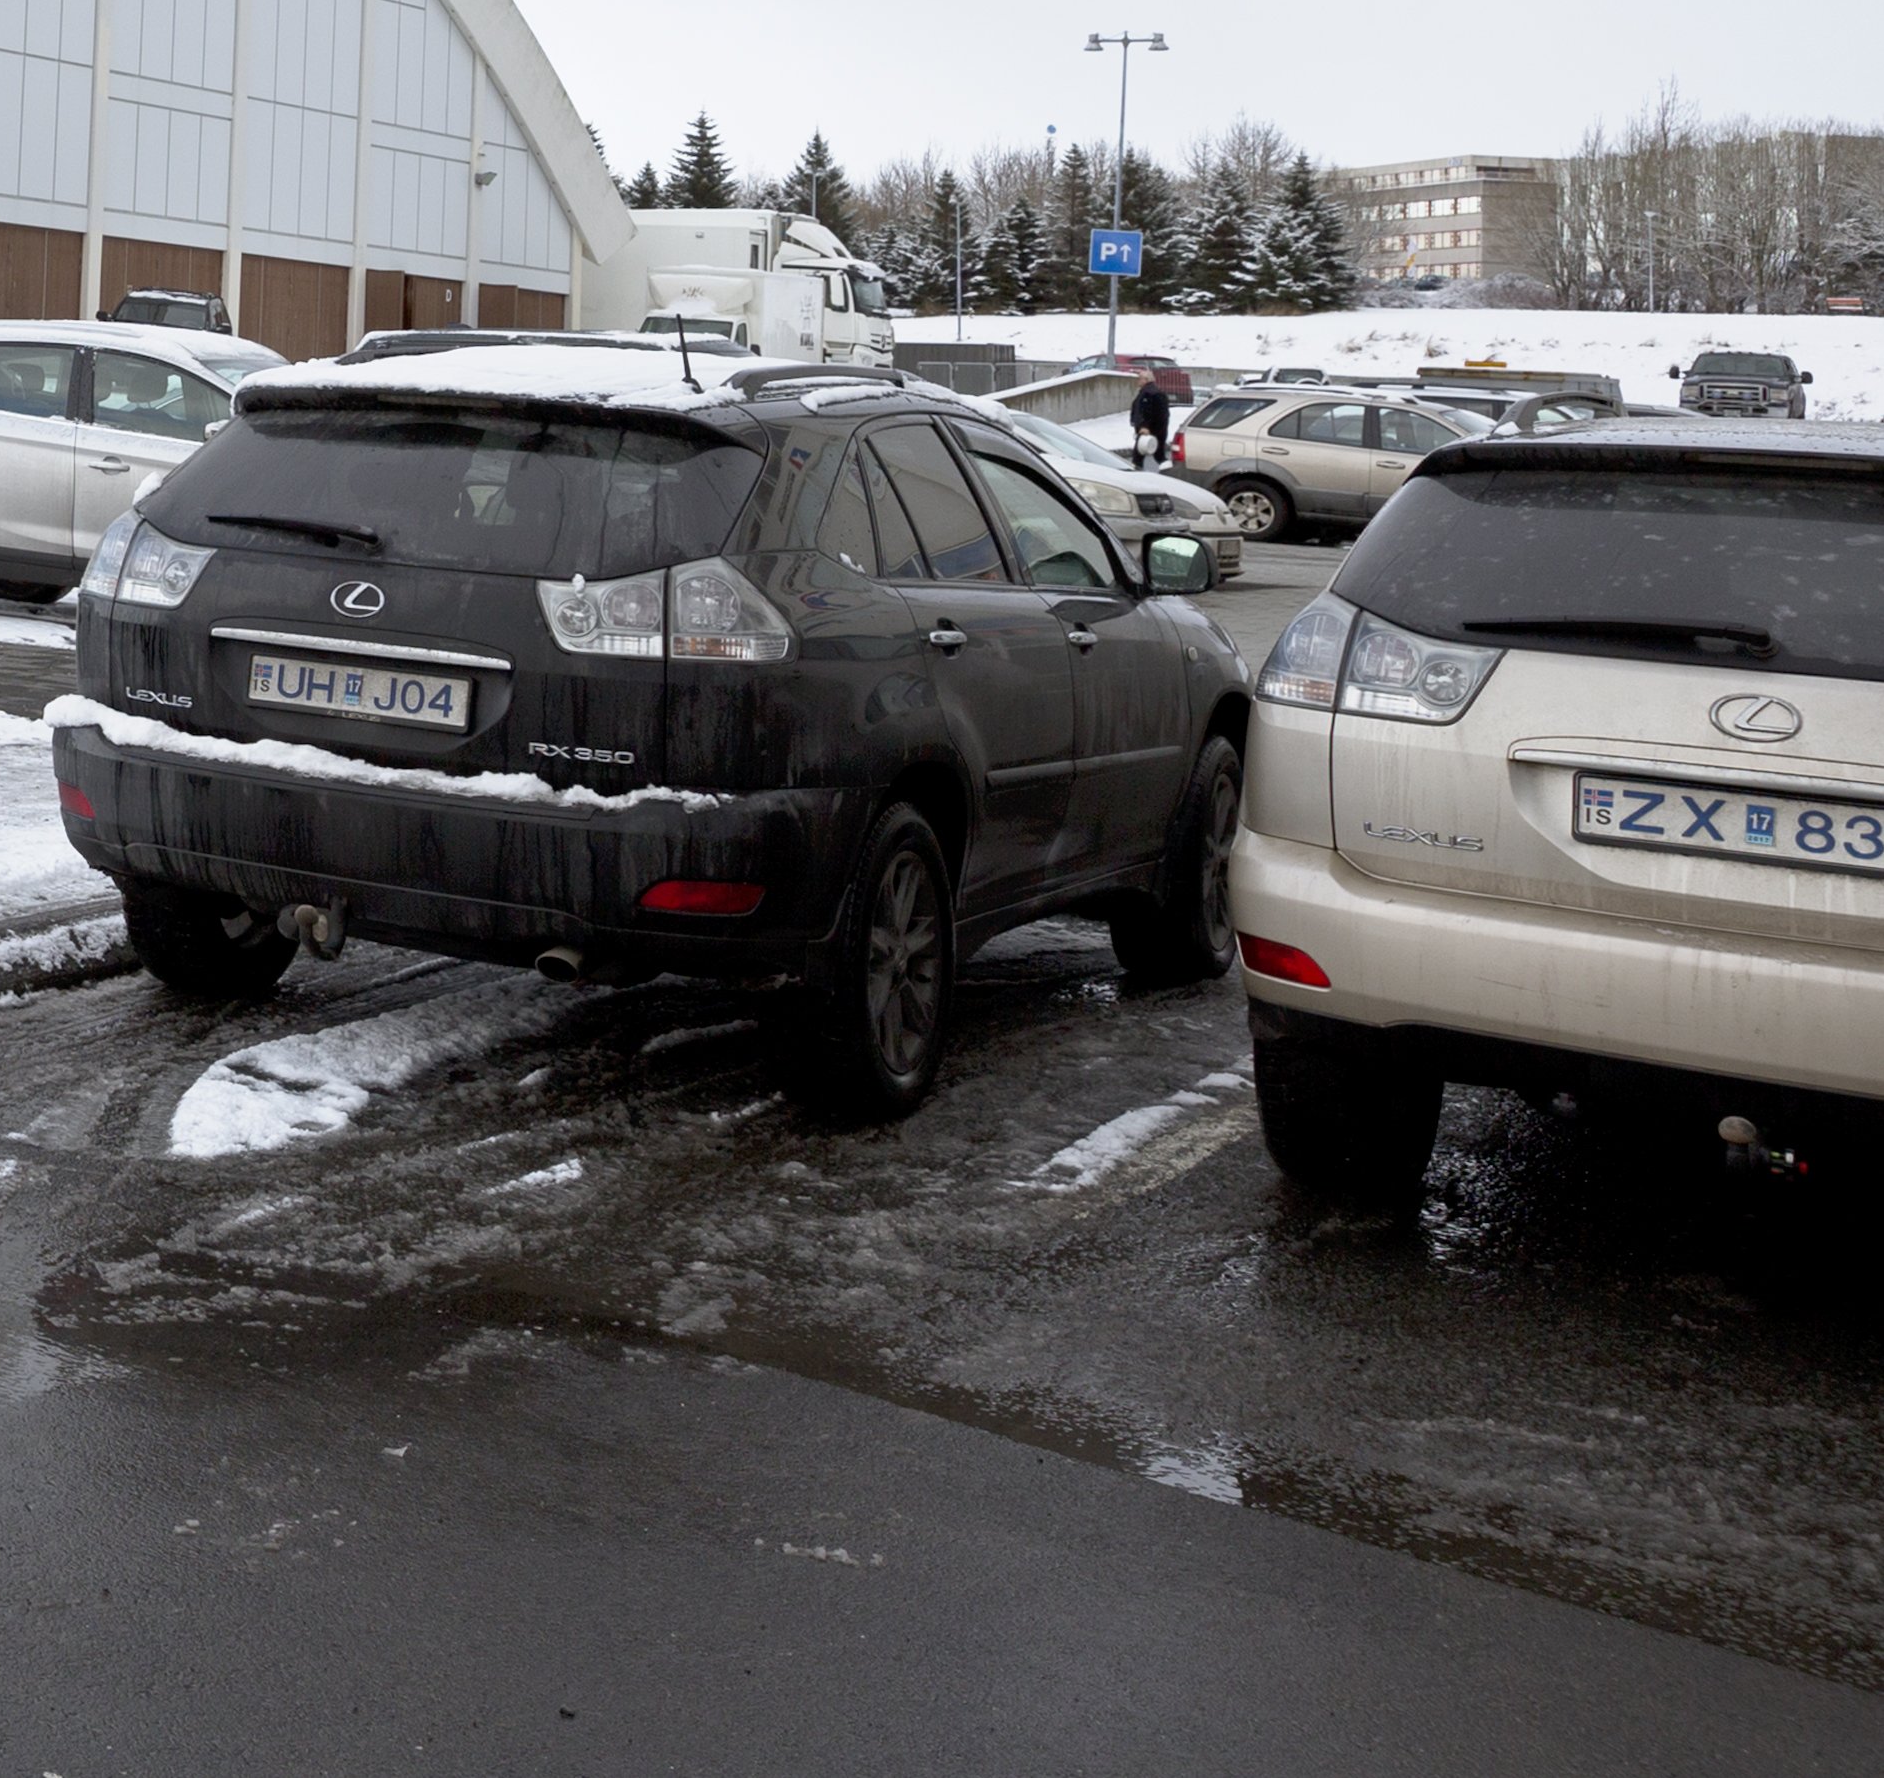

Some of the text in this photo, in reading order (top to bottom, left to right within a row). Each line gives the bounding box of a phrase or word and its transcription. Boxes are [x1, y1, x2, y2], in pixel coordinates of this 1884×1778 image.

[1100, 242, 1118, 261] P
[253, 678, 271, 692] IS
[277, 664, 454, 718] UH 17 J04
[125, 686, 193, 709] LEXUS
[529, 742, 635, 764] RX 350
[1585, 809, 1612, 825] IS
[1619, 790, 1884, 860] ZX 17 83
[1363, 821, 1484, 852] LEXUS
